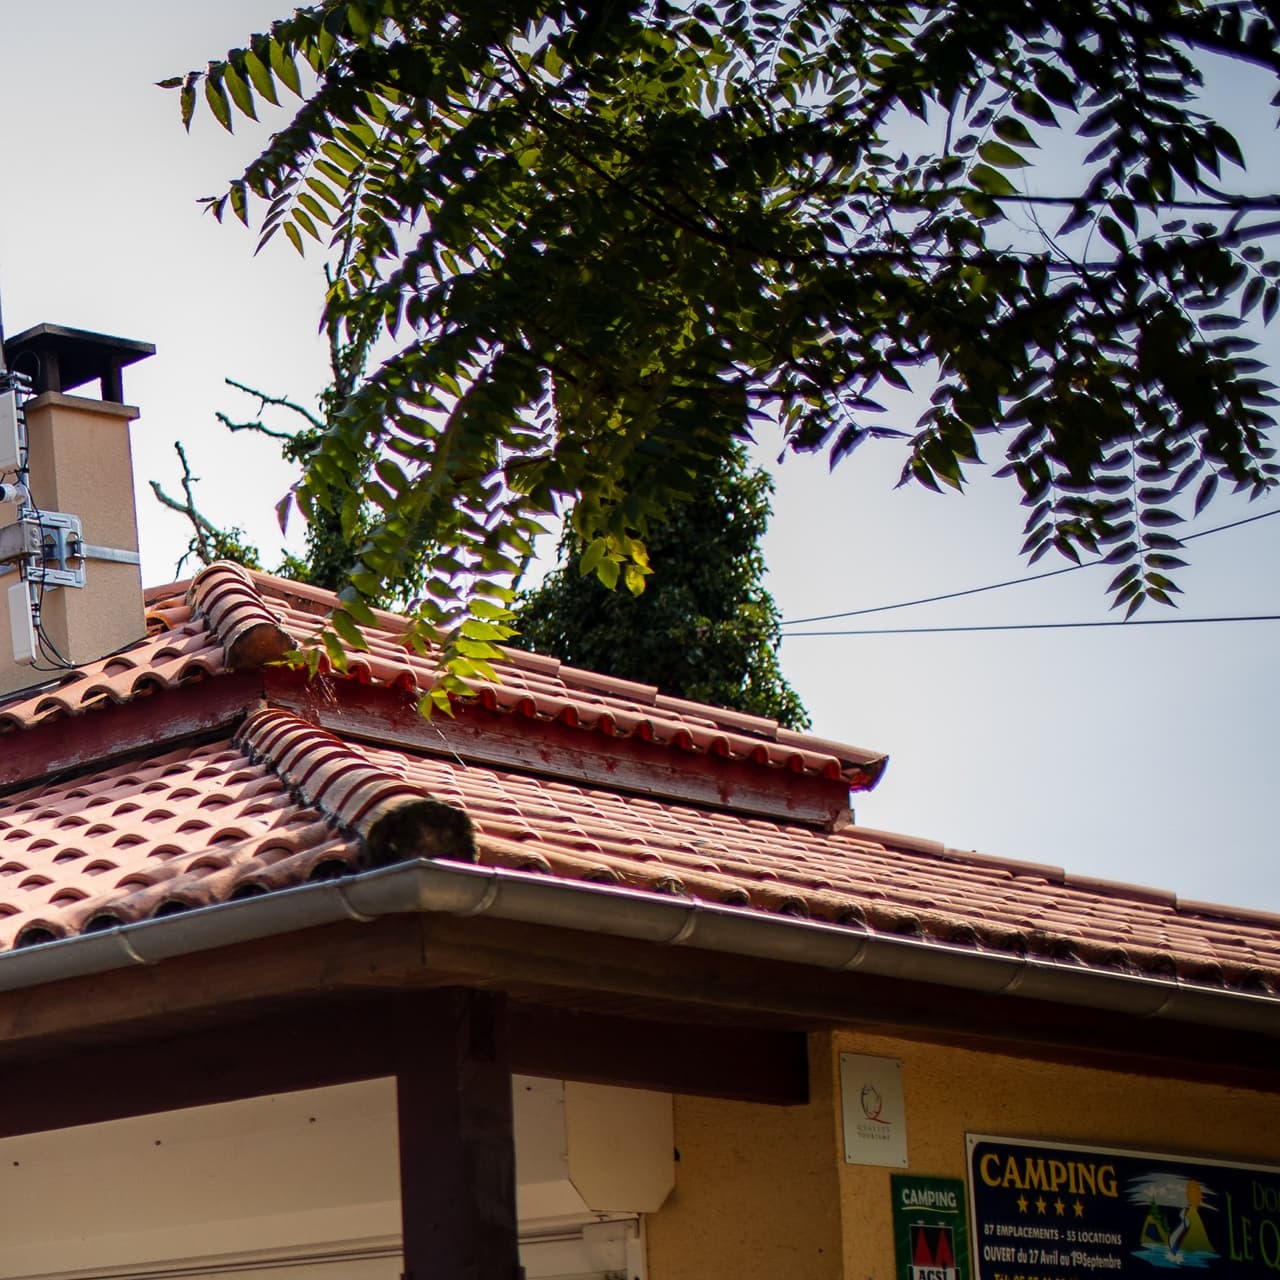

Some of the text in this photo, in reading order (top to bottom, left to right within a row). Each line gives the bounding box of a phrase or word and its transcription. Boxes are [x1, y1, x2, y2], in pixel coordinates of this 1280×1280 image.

[980, 1152, 1120, 1198] CAMPING
[901, 1188, 958, 1208] CAMPING
[1252, 1178, 1280, 1212] DO
[996, 1223, 1060, 1241] EMPLACEMENTS
[1077, 1230, 1123, 1246] LOCATIONS
[984, 1245, 1016, 1262] OUVERT
[1017, 1247, 1028, 1263] du
[1040, 1249, 1059, 1266] Avril
[1060, 1254, 1070, 1267] au
